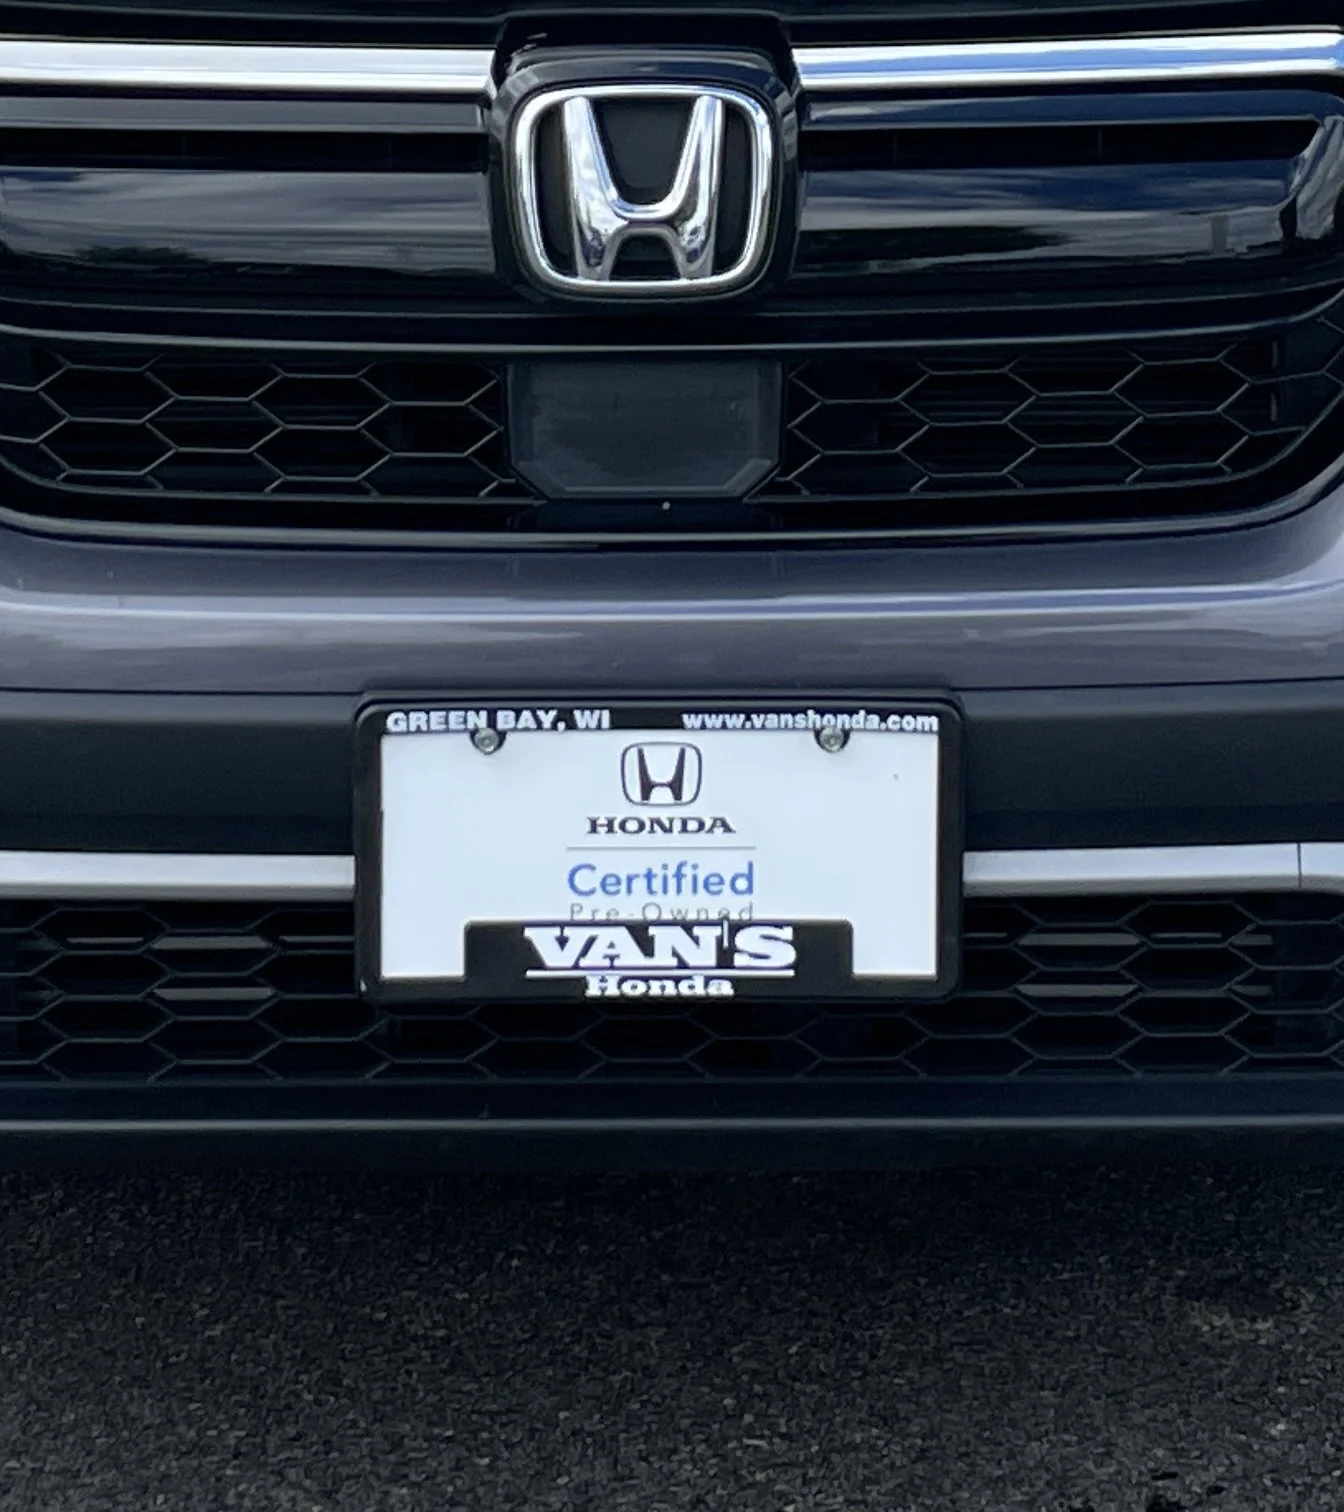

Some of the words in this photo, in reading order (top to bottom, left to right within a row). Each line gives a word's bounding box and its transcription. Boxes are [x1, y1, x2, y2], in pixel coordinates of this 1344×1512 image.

[385, 710, 488, 733] GREEN
[496, 709, 567, 733] BAY,
[573, 709, 611, 730] WI
[681, 709, 940, 733] www.vanshonda.com
[585, 816, 737, 836] HONDA
[567, 860, 755, 897] Certified
[569, 901, 754, 922] Pre-Owned
[523, 923, 797, 970] VAN'S
[584, 974, 736, 998] Honda
